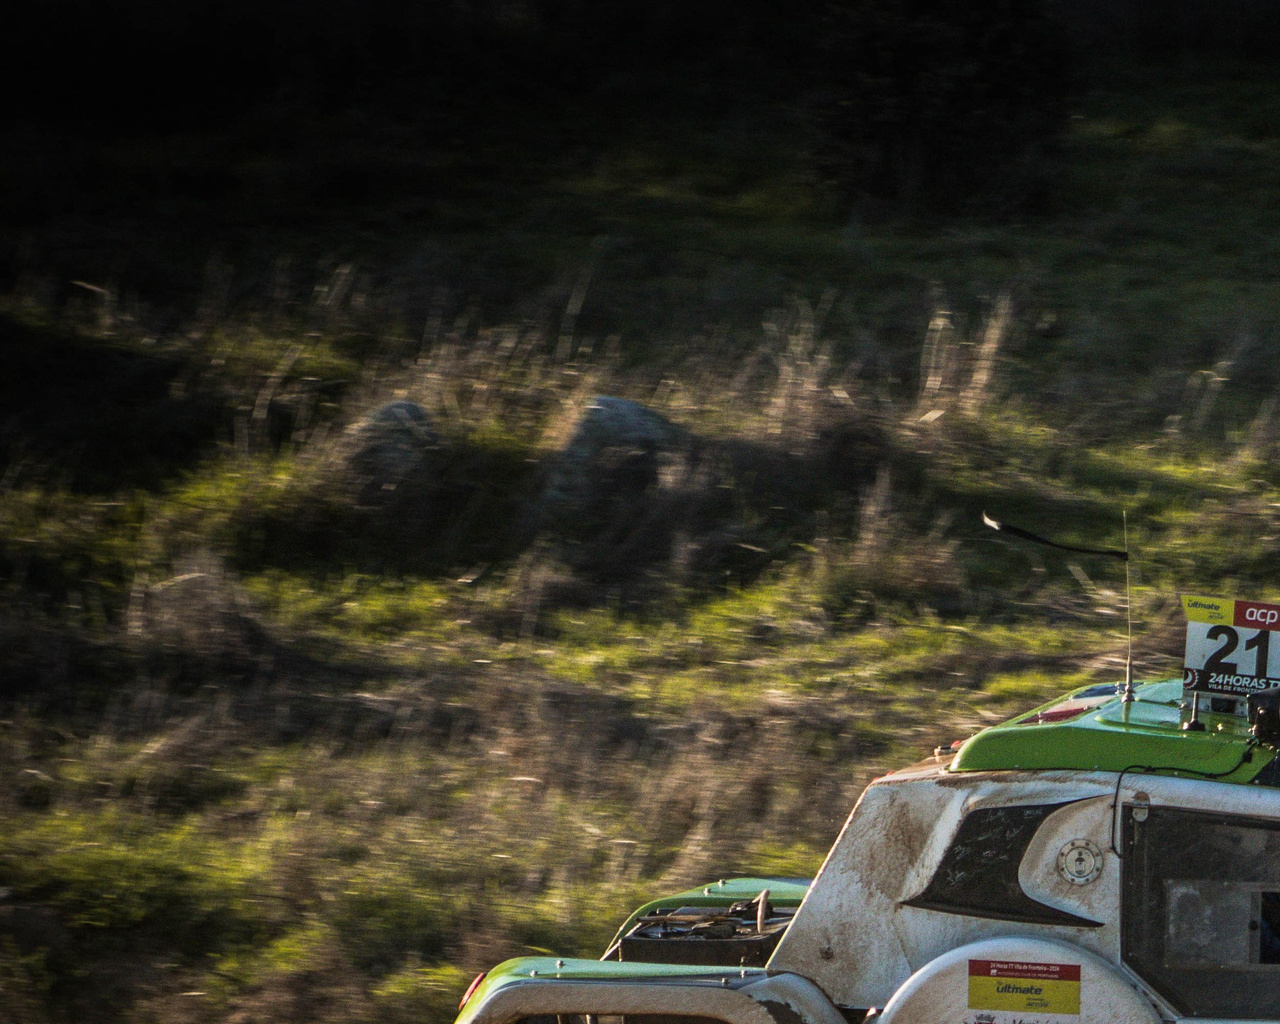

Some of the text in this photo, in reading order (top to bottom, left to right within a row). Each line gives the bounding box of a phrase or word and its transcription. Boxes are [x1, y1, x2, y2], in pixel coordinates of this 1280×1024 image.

[1245, 607, 1278, 625] acp
[1204, 625, 1270, 678] 21
[996, 984, 1043, 995] ultimate
